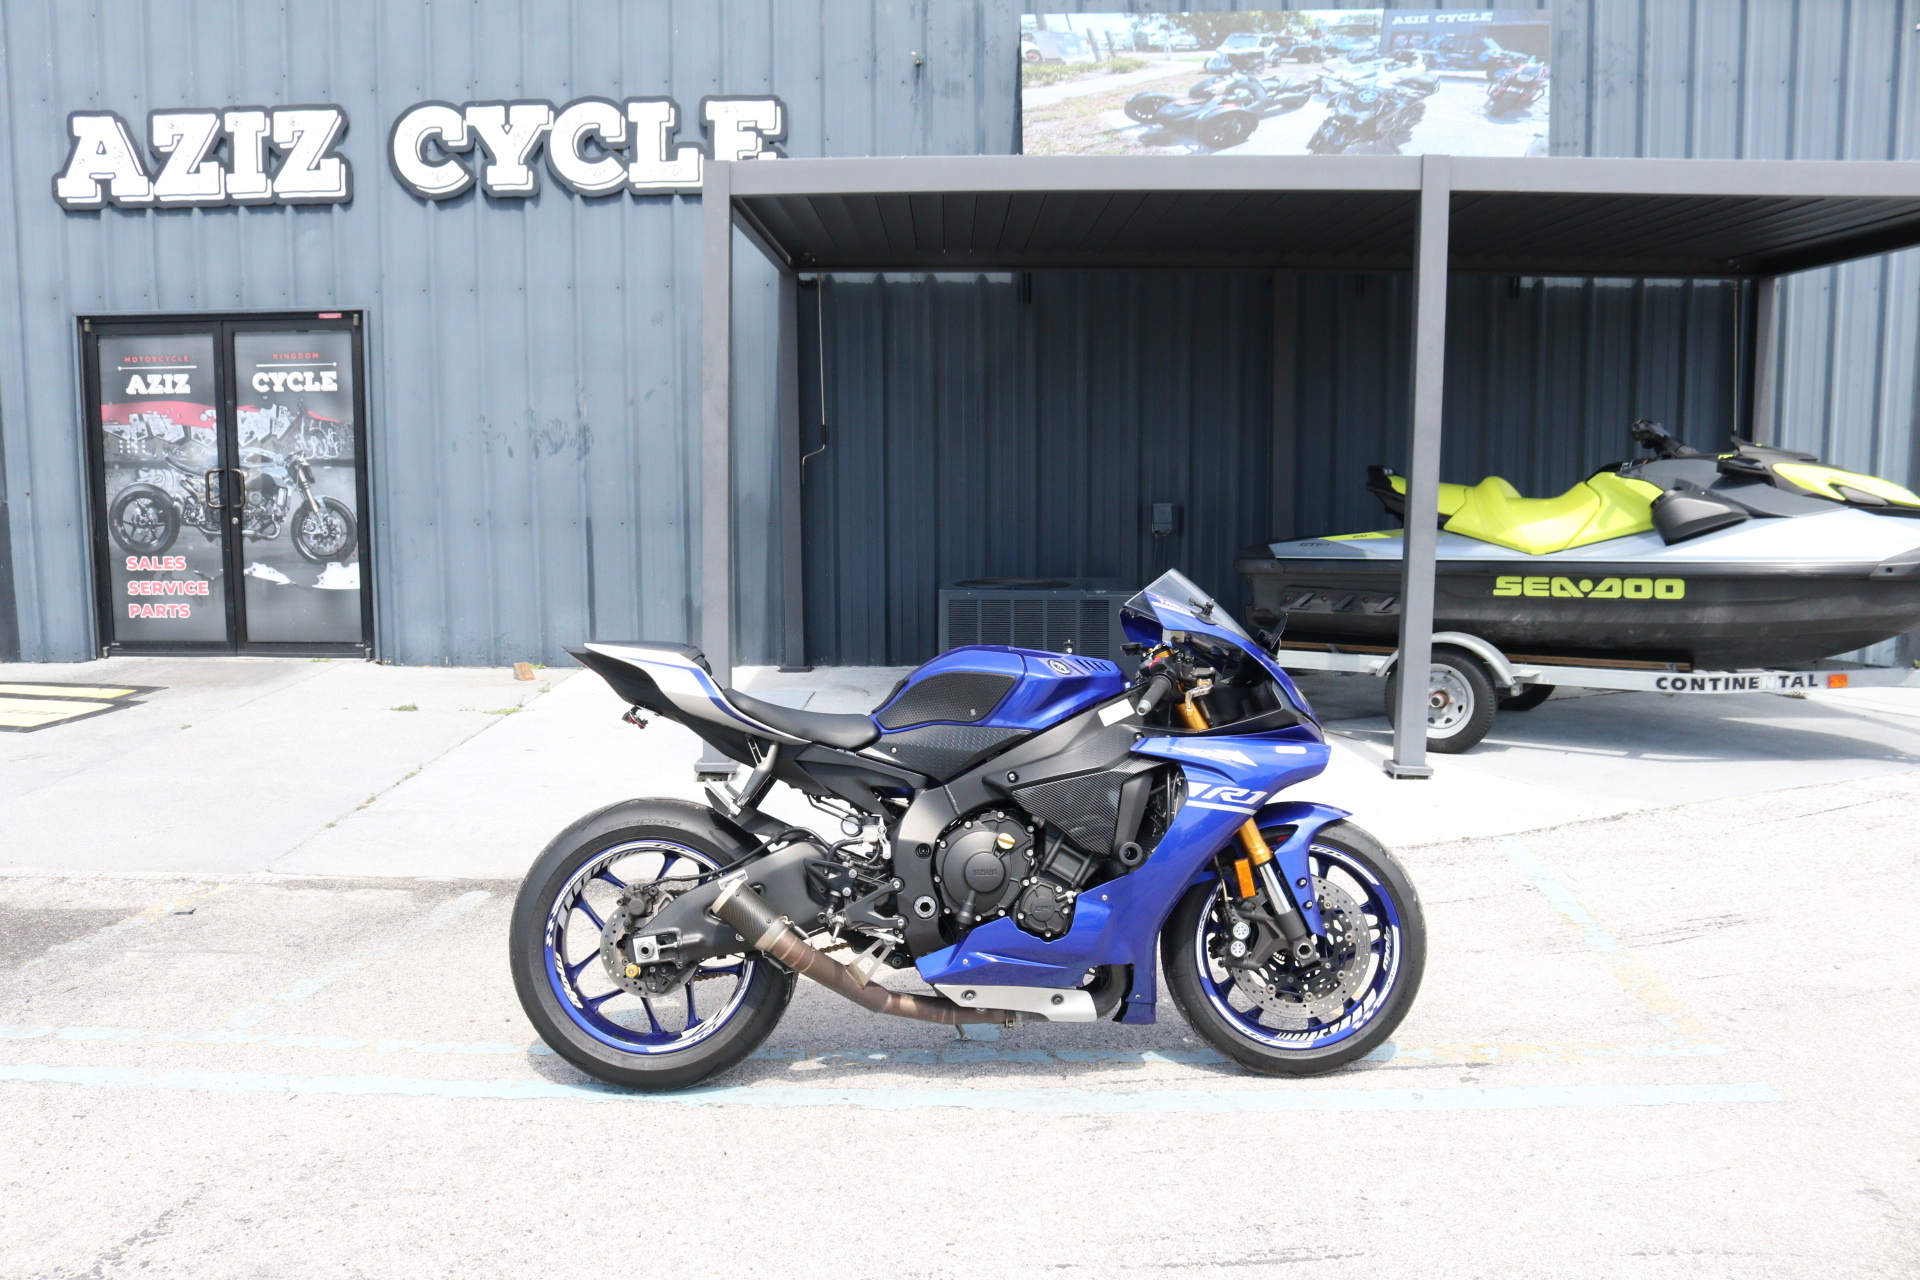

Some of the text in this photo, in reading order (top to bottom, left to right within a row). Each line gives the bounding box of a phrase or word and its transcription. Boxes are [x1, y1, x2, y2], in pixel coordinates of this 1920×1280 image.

[1435, 12, 1493, 23] CYCLE
[56, 100, 782, 204] AZIZ CYCLE
[124, 355, 190, 363] MOTORCYCLE
[273, 352, 320, 360] KINGDOM
[126, 373, 191, 395] AZIZ
[252, 371, 338, 393] CYCLE
[126, 556, 187, 571] SALES
[127, 580, 209, 595] SERVICE
[128, 603, 191, 618] PARTS
